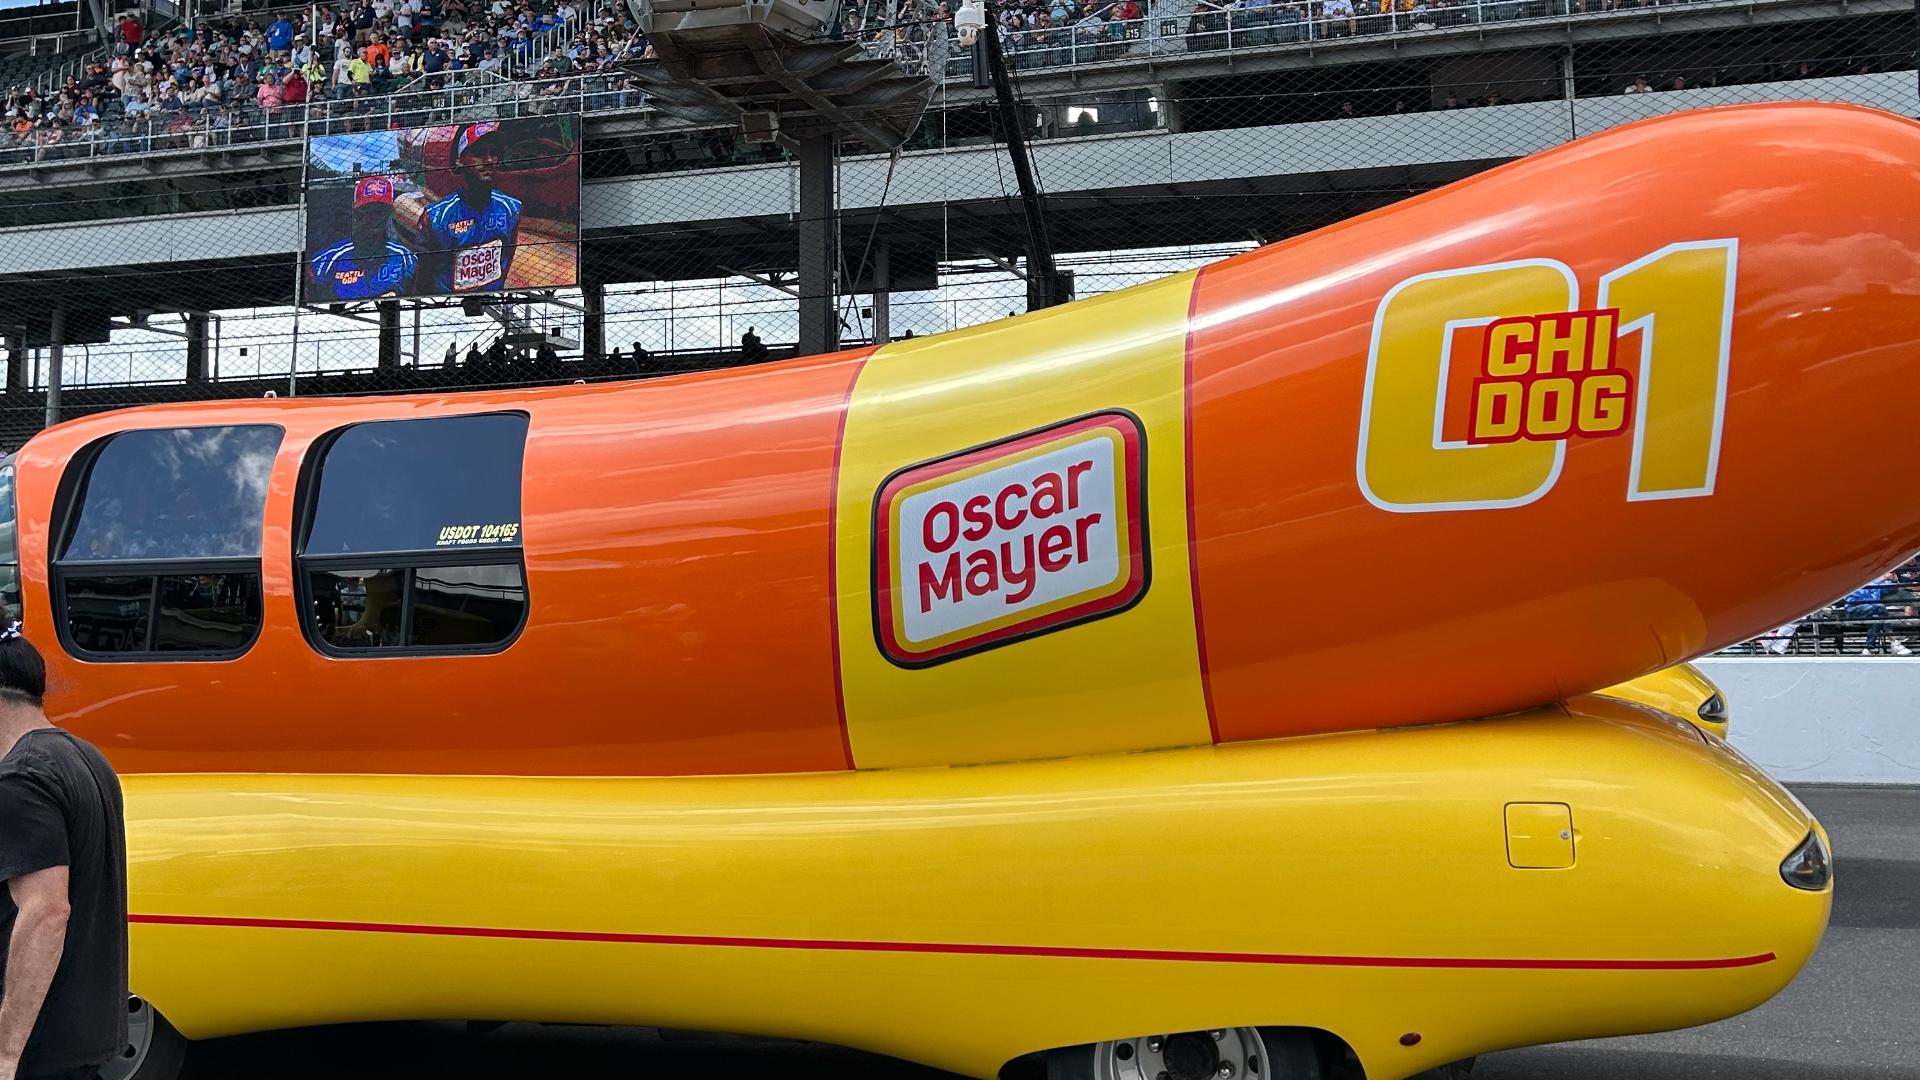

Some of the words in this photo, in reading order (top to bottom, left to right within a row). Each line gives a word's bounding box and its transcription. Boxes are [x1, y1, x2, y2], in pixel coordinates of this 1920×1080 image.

[460, 260, 498, 281] Mayer
[462, 247, 497, 267] Oscar
[1487, 313, 1613, 377] CHI
[1474, 374, 1627, 438] DOG
[440, 525, 480, 540] USDOT
[480, 523, 519, 538] 104165
[922, 460, 1093, 553] Oscar
[918, 513, 1102, 614] Mayer
